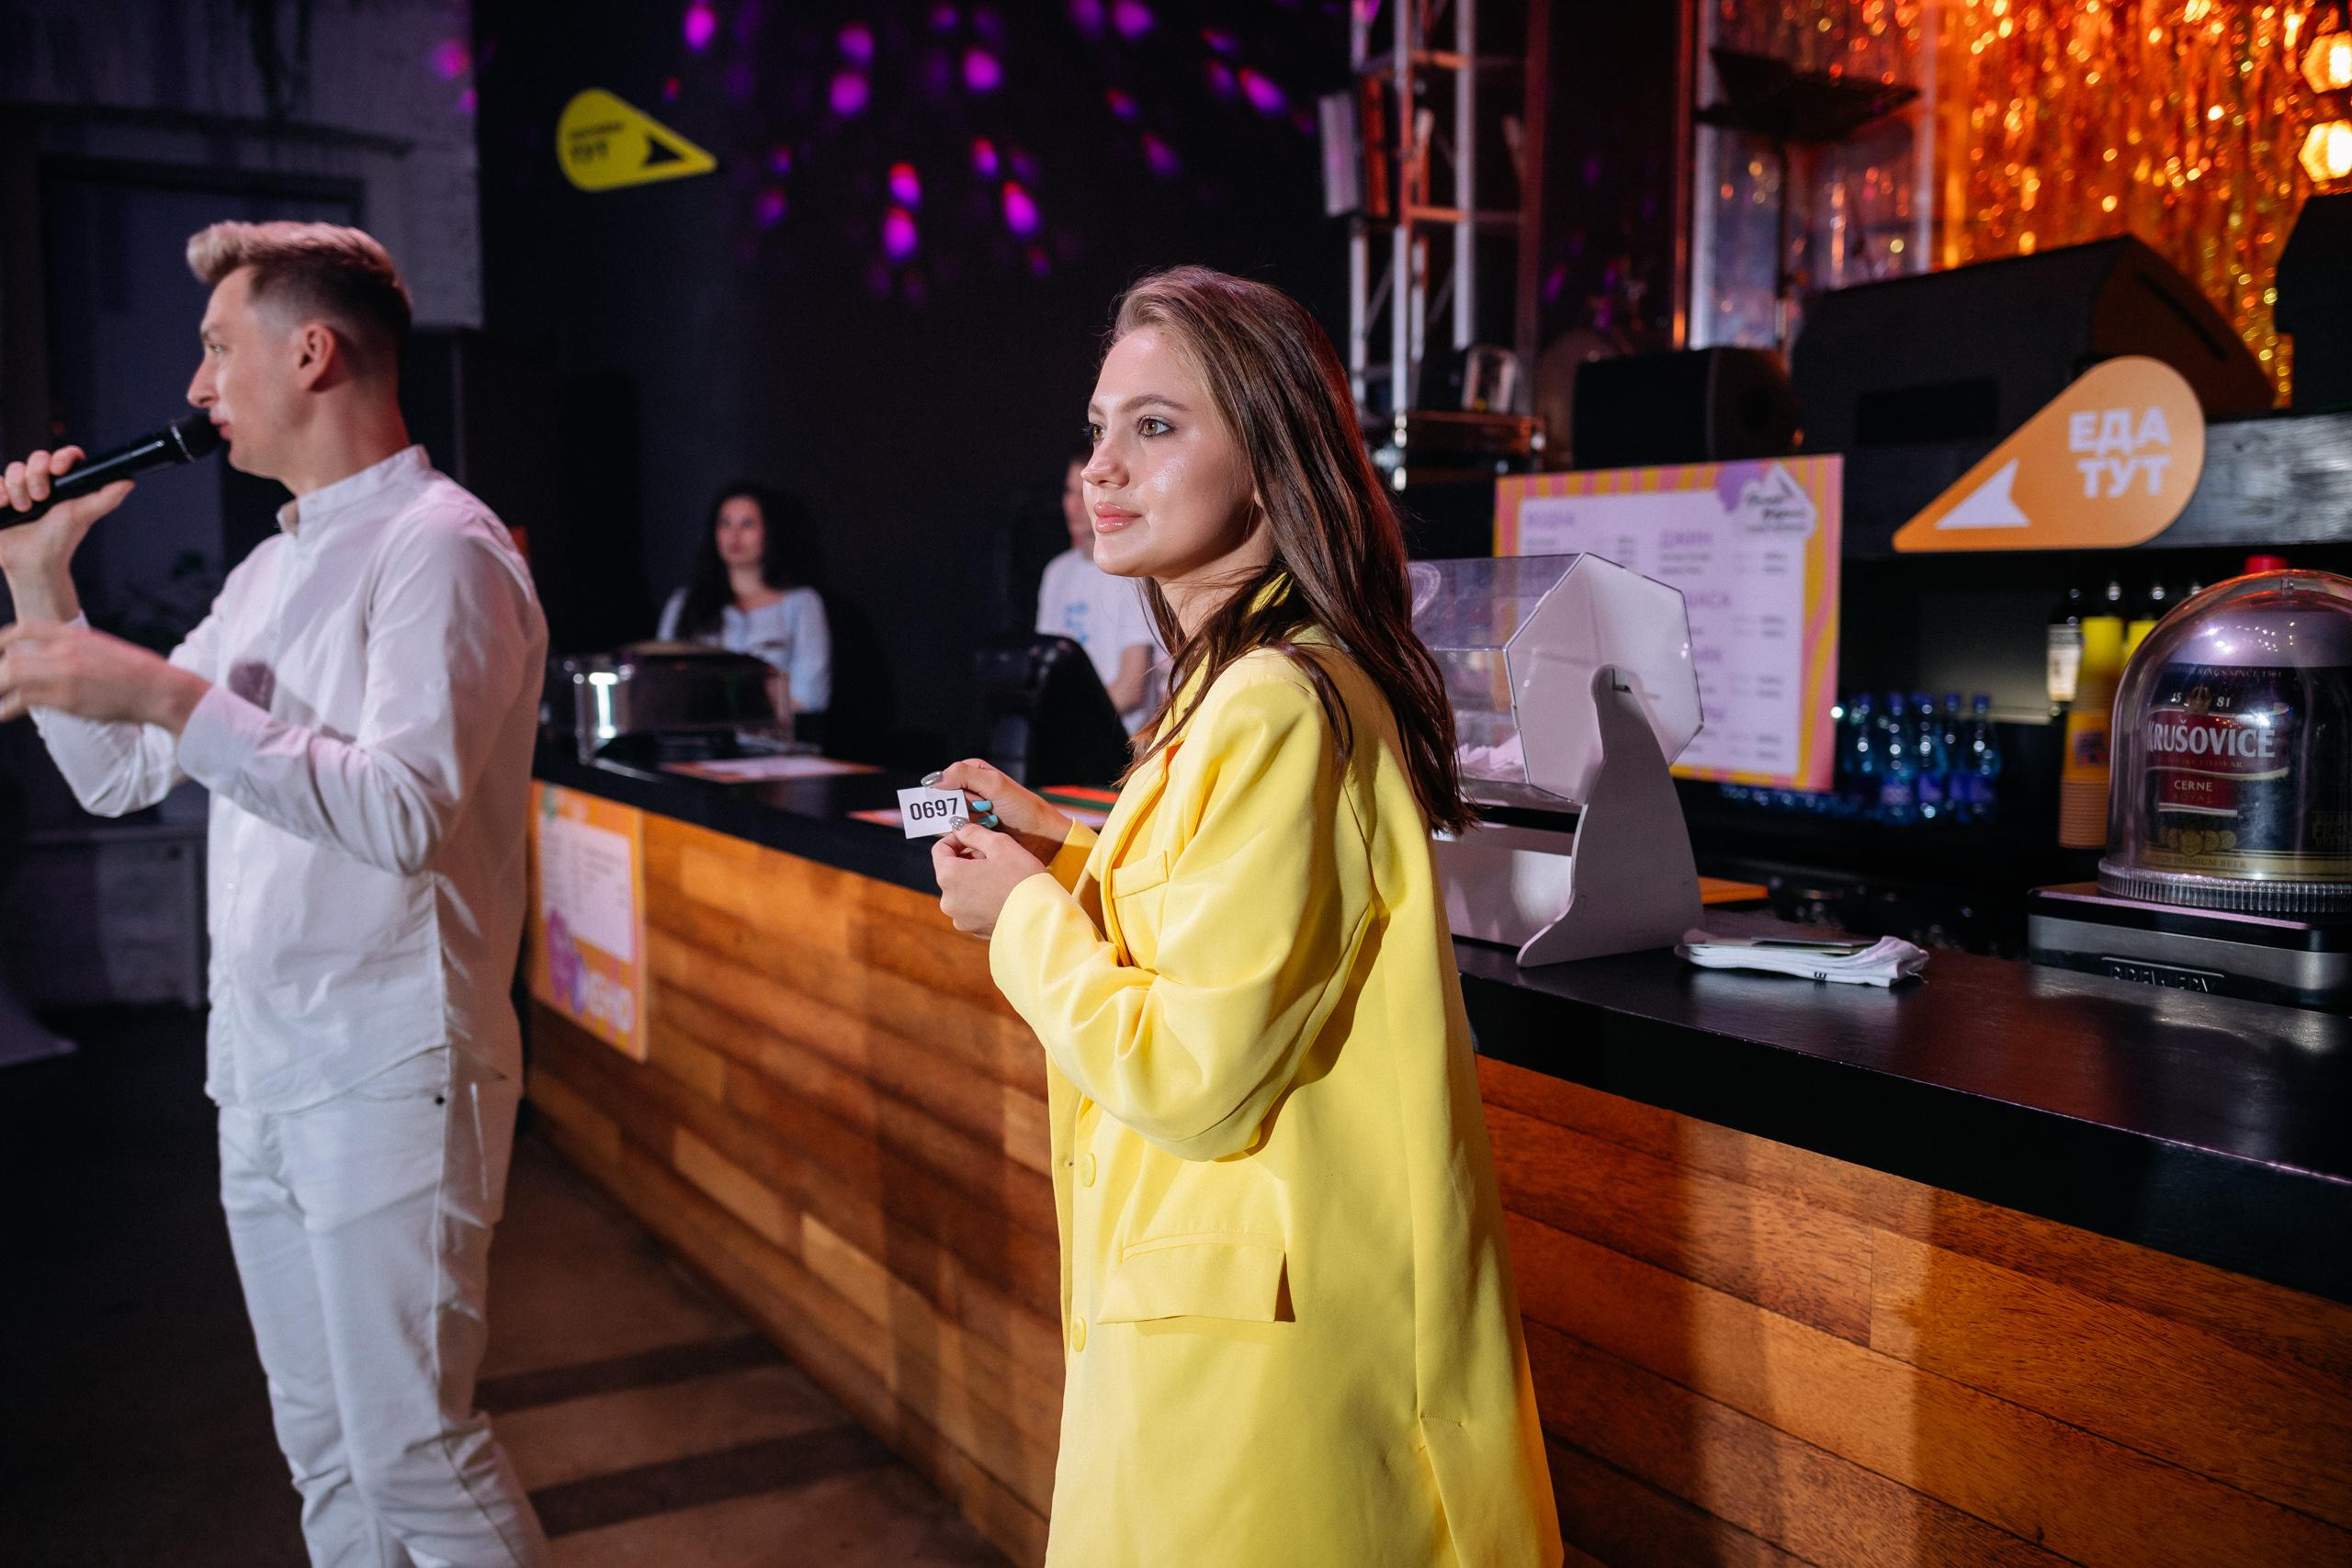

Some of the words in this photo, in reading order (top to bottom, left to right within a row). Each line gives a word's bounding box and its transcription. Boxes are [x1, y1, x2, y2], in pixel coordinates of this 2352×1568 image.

[2069, 407, 2172, 457] ЕДА
[2077, 455, 2171, 499] ТУТ
[2171, 692, 2182, 703] 15
[2216, 696, 2232, 707] 81
[2146, 719, 2276, 758] KRUŠOVICE
[910, 797, 958, 820] 0697
